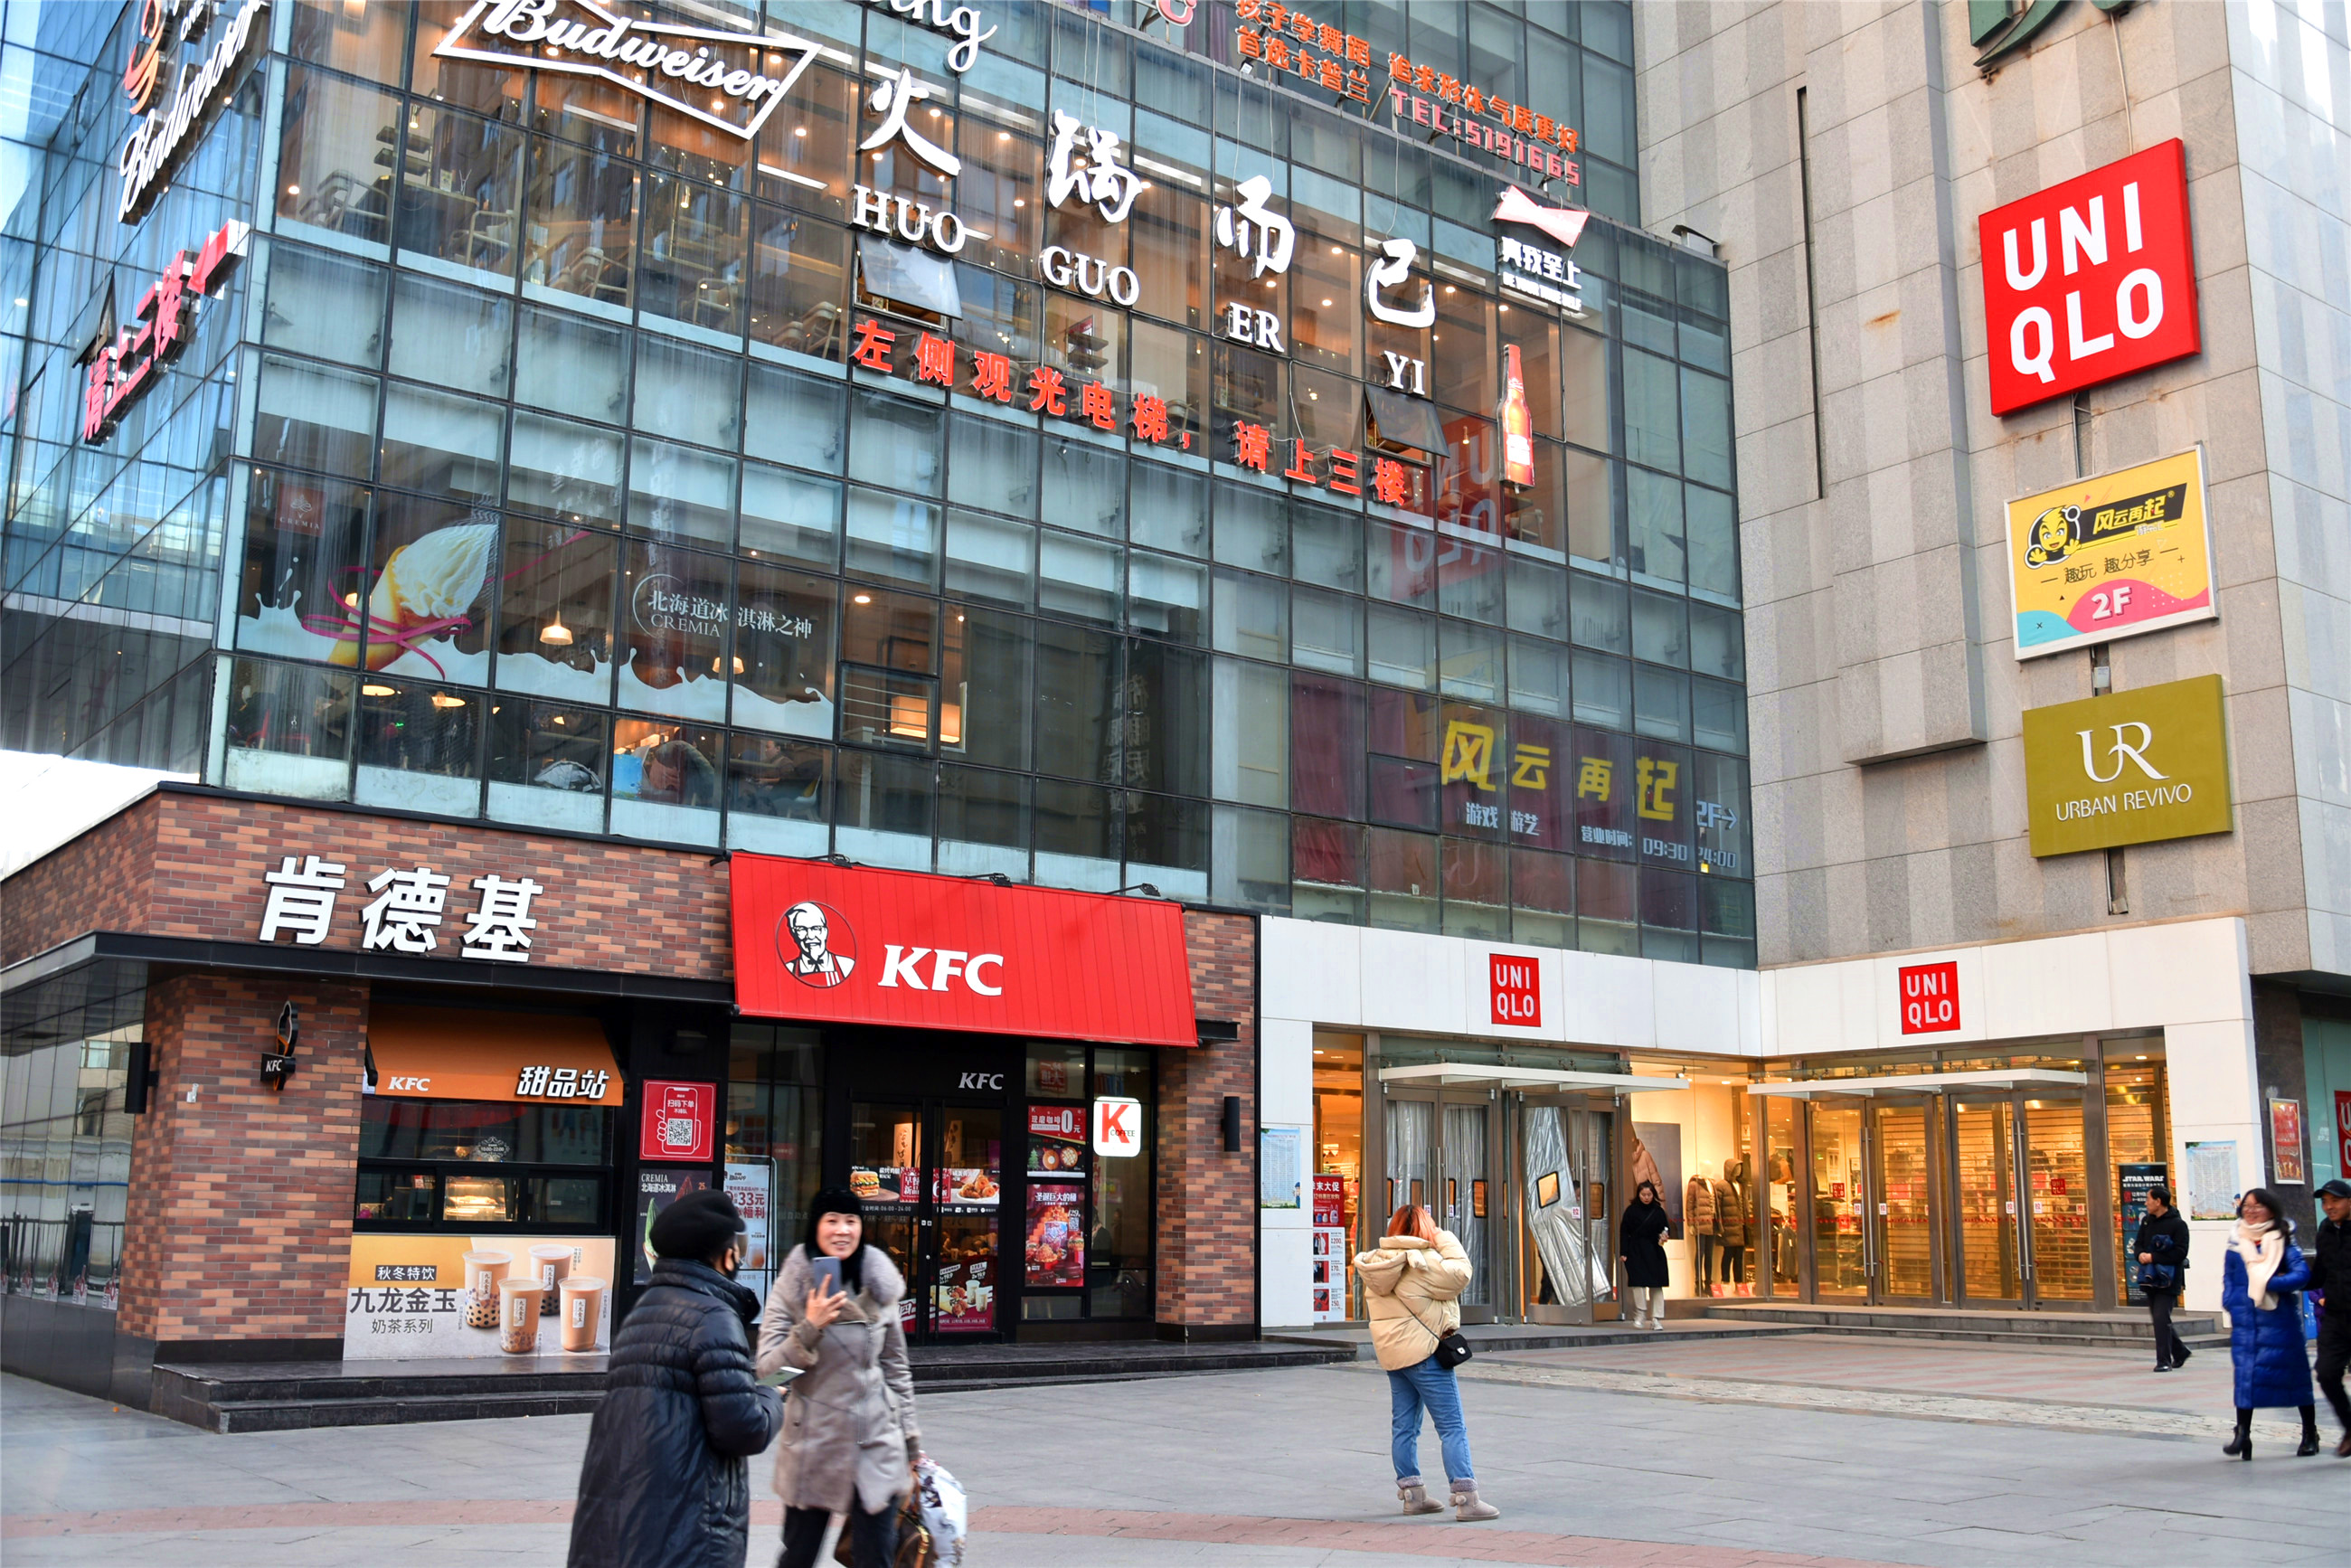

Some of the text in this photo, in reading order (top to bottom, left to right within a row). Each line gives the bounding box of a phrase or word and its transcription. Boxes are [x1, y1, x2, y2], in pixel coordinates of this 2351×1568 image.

[477, 0, 780, 106] Budweiser
[1236, 25, 1372, 105] 首选卡普兰
[1388, 52, 1580, 155] 追求形体气质更好
[1389, 88, 1581, 187] TEL:5191665
[2002, 181, 2143, 291] UNI
[853, 184, 1426, 396] HUO GUO ER YI
[2010, 268, 2165, 383] QLO
[2092, 495, 2167, 535] 风云再起
[2063, 549, 2154, 585] 趣玩 趣分享
[2091, 587, 2132, 620] 2F
[650, 613, 722, 638] CREMIA
[2076, 722, 2169, 783] UR
[1440, 720, 1679, 822] 风云再起
[2055, 783, 2193, 822] URBAN REVIVO
[1642, 837, 1688, 862] 09:30
[259, 855, 544, 963] 肯德基
[877, 943, 1005, 997] KFC
[1496, 964, 1531, 989] UNI
[1906, 972, 1948, 997] UNI
[1497, 993, 1534, 1019] QLO
[1908, 999, 1953, 1029] QLO
[265, 1058, 283, 1072] KFC
[958, 1072, 1005, 1091] KFC
[388, 1076, 430, 1092] KFC
[515, 1065, 610, 1100] 甜品站
[1101, 1103, 1130, 1143] K
[1109, 1129, 1136, 1138] COFFEE
[641, 1173, 668, 1183] CREMIA
[738, 1192, 765, 1206] 33元
[377, 1266, 435, 1280] 秋冬特饮
[350, 1287, 458, 1314] 九龙金玉
[371, 1318, 433, 1334] 奶茶系列
